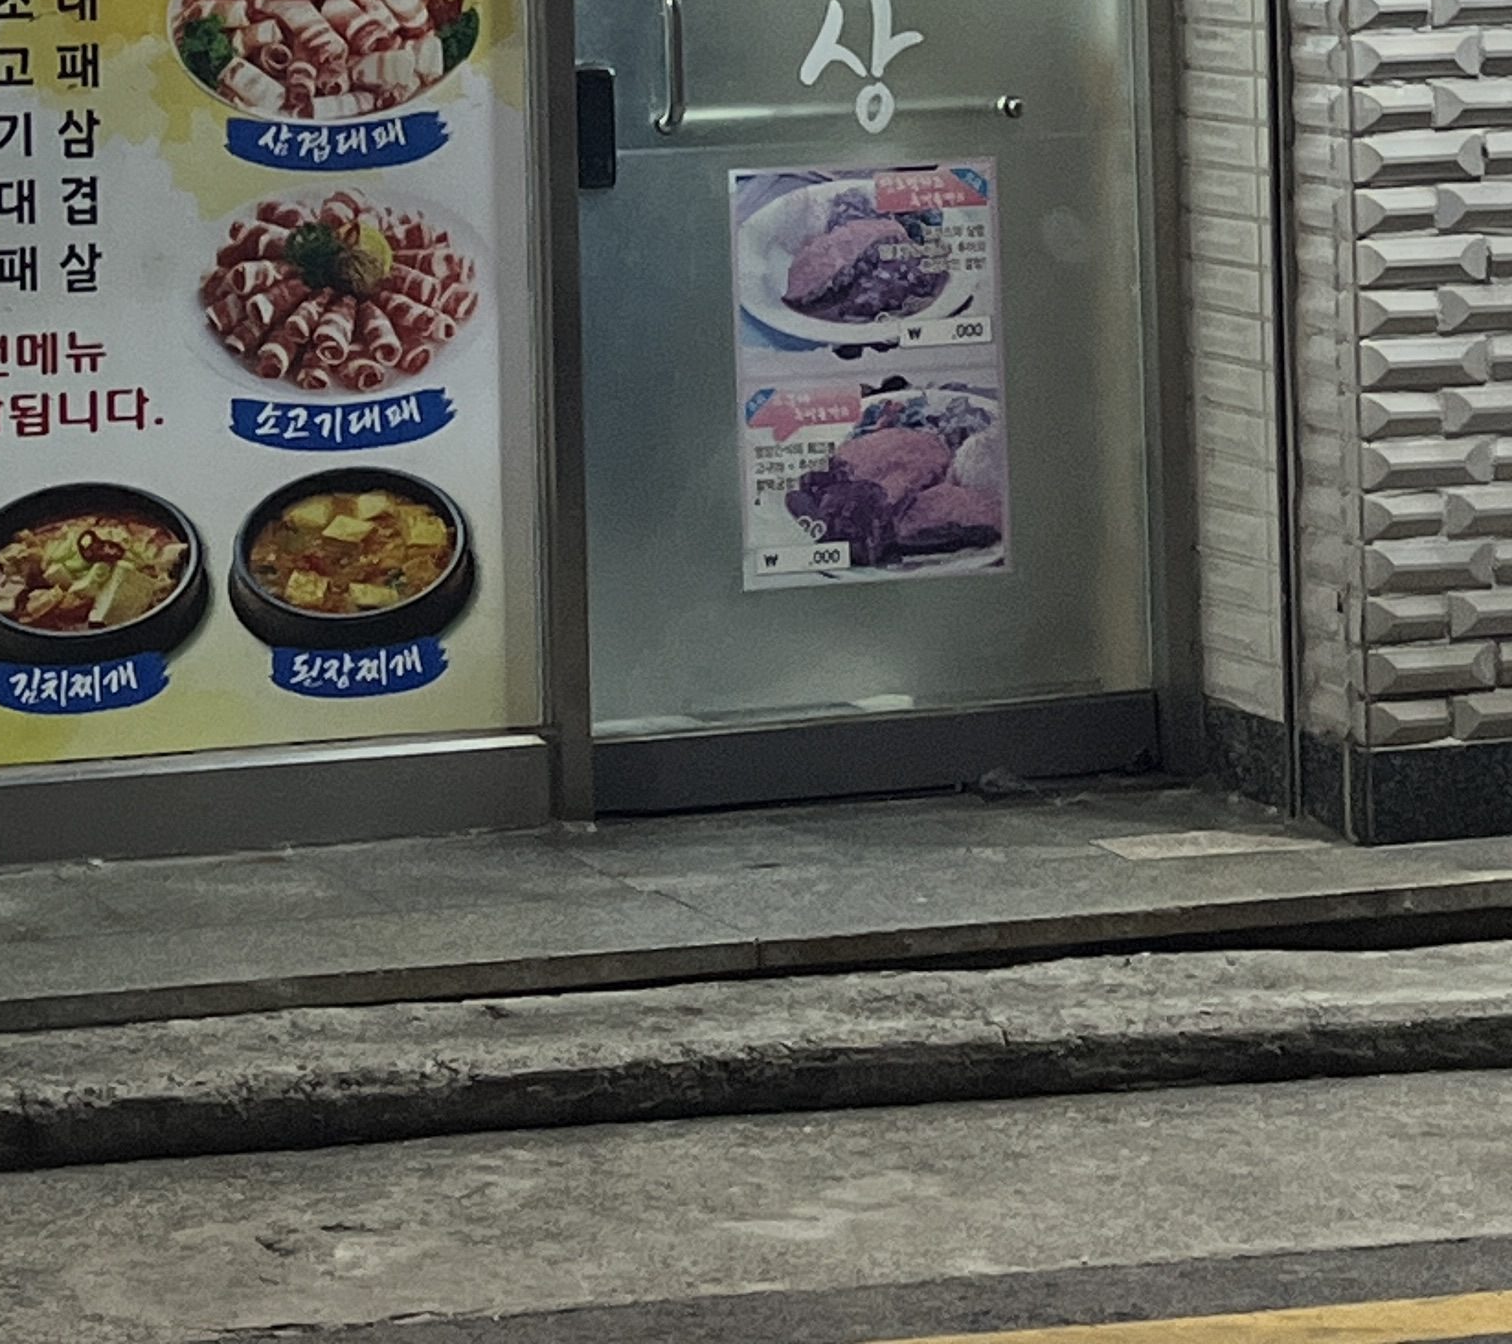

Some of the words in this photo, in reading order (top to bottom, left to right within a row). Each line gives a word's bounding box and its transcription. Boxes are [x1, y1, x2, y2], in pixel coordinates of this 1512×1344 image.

[257, 118, 407, 164] 삼겹대패
[255, 394, 423, 444] 소고기대패
[8, 661, 139, 708] 김치찌개
[289, 645, 423, 689] 된장찌개
